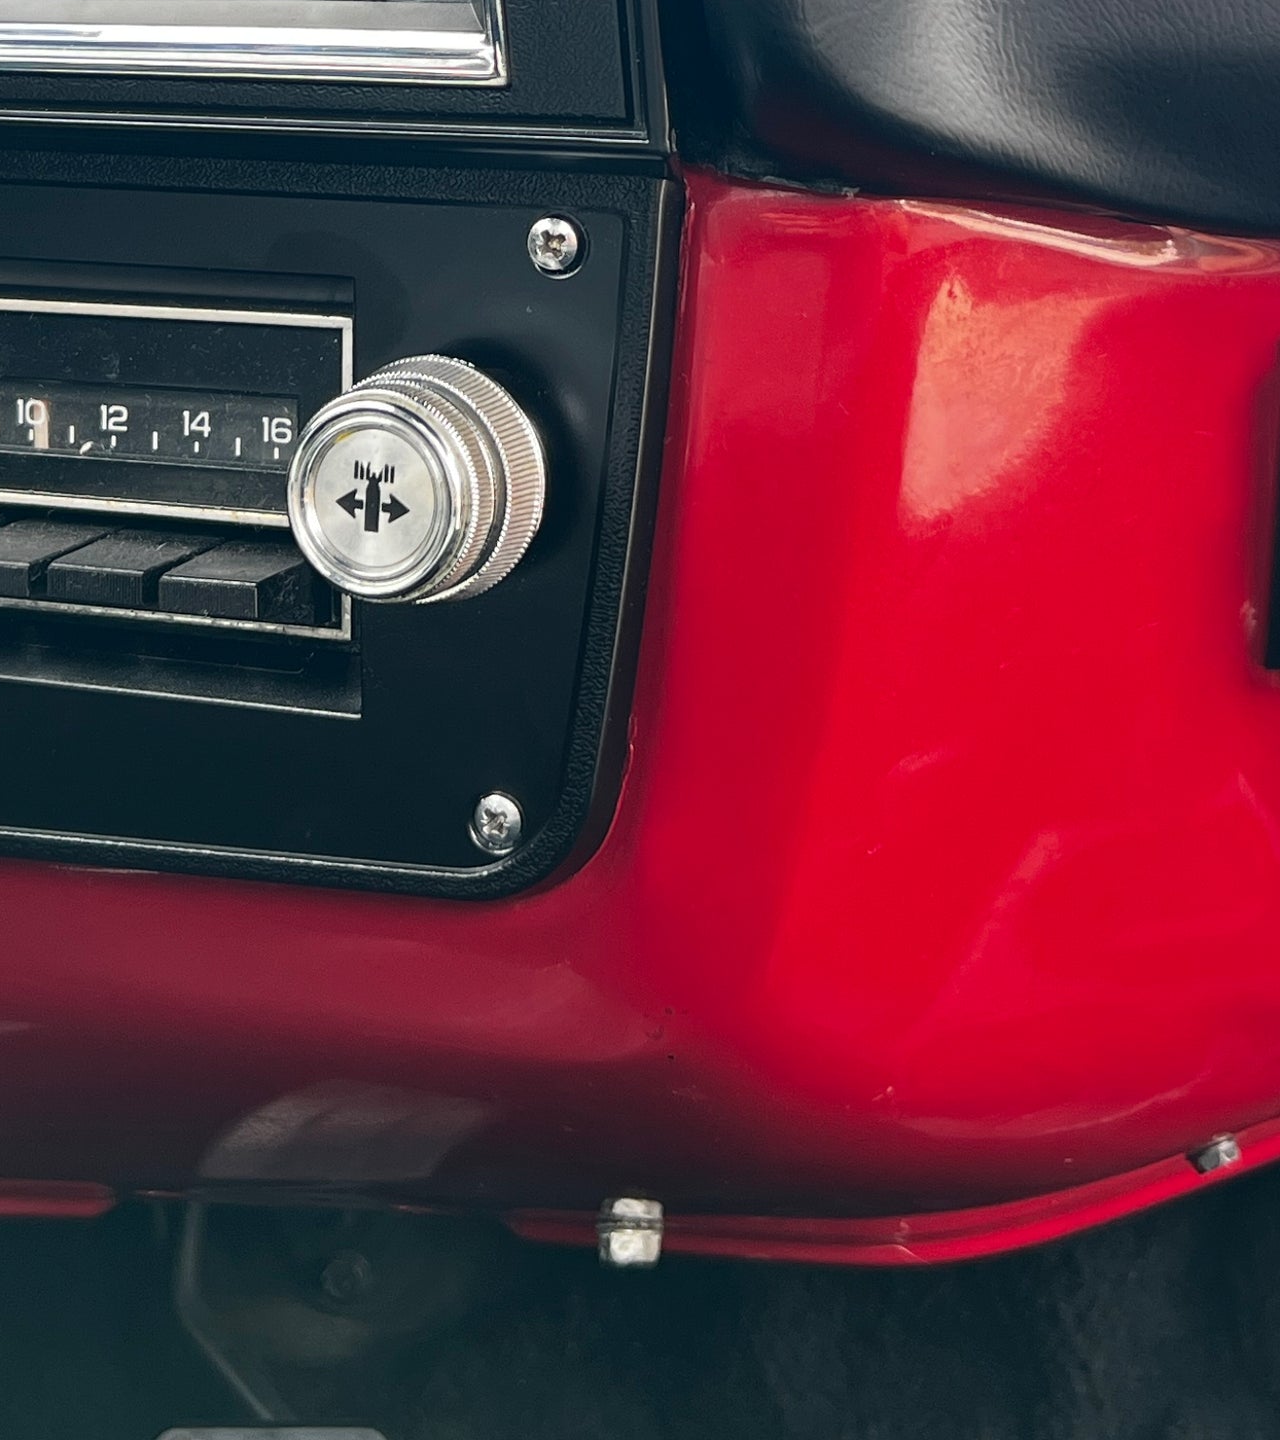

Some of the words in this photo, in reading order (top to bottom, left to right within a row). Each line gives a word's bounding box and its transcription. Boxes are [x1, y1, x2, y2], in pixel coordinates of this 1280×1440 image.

[17, 397, 46, 425] 10
[100, 404, 129, 432] 12
[183, 410, 211, 438] 14
[262, 416, 293, 444] 16
